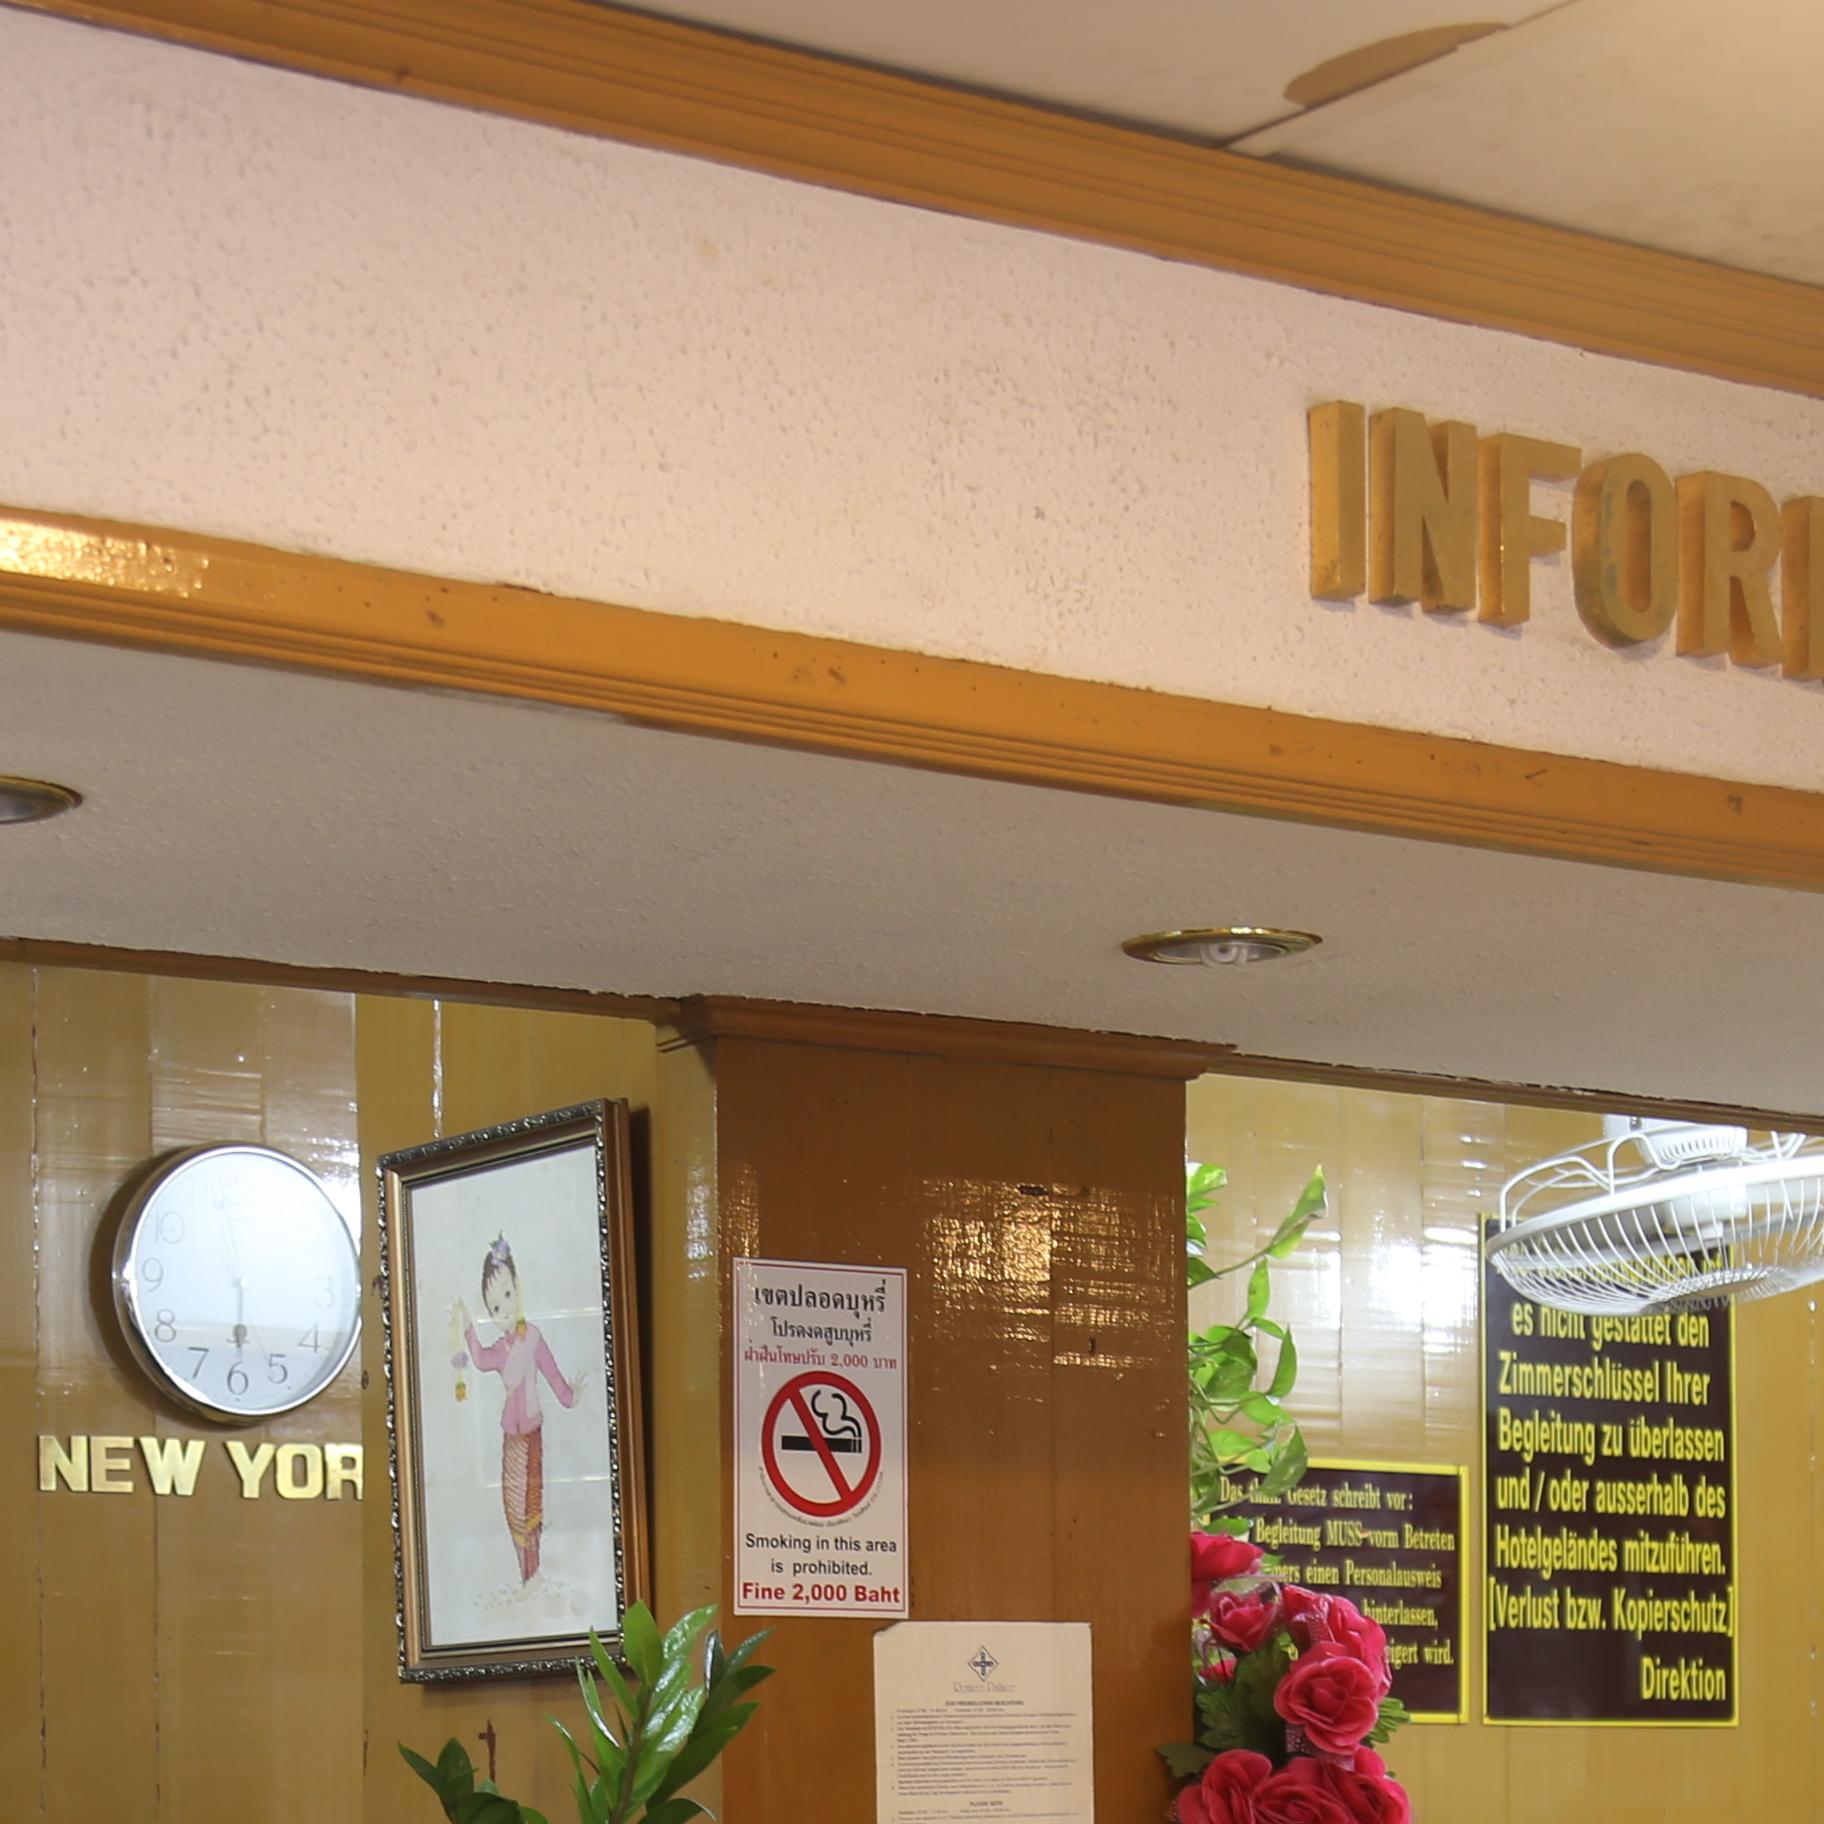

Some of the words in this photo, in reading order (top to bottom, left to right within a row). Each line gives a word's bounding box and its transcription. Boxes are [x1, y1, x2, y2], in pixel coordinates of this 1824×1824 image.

[1512, 1302, 1533, 1336] es
[1678, 1312, 1709, 1348] den
[1498, 1351, 1659, 1402] Zimmerschlüssel
[1667, 1360, 1710, 1405] Ihrer
[1498, 1407, 1595, 1465] Begleitung
[1602, 1424, 1623, 1457] zu
[1630, 1416, 1724, 1462] überlassen
[38, 1435, 205, 1496] NEW
[226, 1441, 364, 1500] YOR
[1220, 1476, 1243, 1502] Das
[1288, 1484, 1327, 1506] Gesetz
[1333, 1482, 1381, 1509] schreibt
[1497, 1466, 1530, 1509] und
[1535, 1470, 1546, 1512] /
[1549, 1469, 1589, 1512] oder
[1596, 1473, 1689, 1517] ausserhalb
[1696, 1476, 1725, 1518] des
[746, 1533, 811, 1553] Smoking
[816, 1536, 829, 1550] in
[834, 1537, 861, 1551] this
[866, 1540, 897, 1552] area
[1256, 1518, 1321, 1550] Begleitung
[1327, 1520, 1362, 1547] MUSS
[1369, 1531, 1399, 1548] vorm
[1405, 1524, 1455, 1551] Betreten
[1496, 1524, 1617, 1580] Hotelgeländes
[1624, 1531, 1725, 1575] mitzuführen.
[771, 1558, 783, 1573] is
[793, 1559, 872, 1576] prohibited.
[1307, 1559, 1339, 1584] einen
[1345, 1559, 1442, 1588] Personalausweis
[743, 1582, 785, 1600] Fine
[792, 1583, 847, 1604] 2,000
[855, 1585, 900, 1603] Baht
[1489, 1576, 1560, 1631] [Verlust
[1566, 1586, 1606, 1630] bzw.
[1614, 1586, 1734, 1641] Kopierschutz]
[1363, 1598, 1438, 1630] hinterlassen,
[1424, 1639, 1454, 1664] wird.
[1641, 1656, 1726, 1700] Direktion
